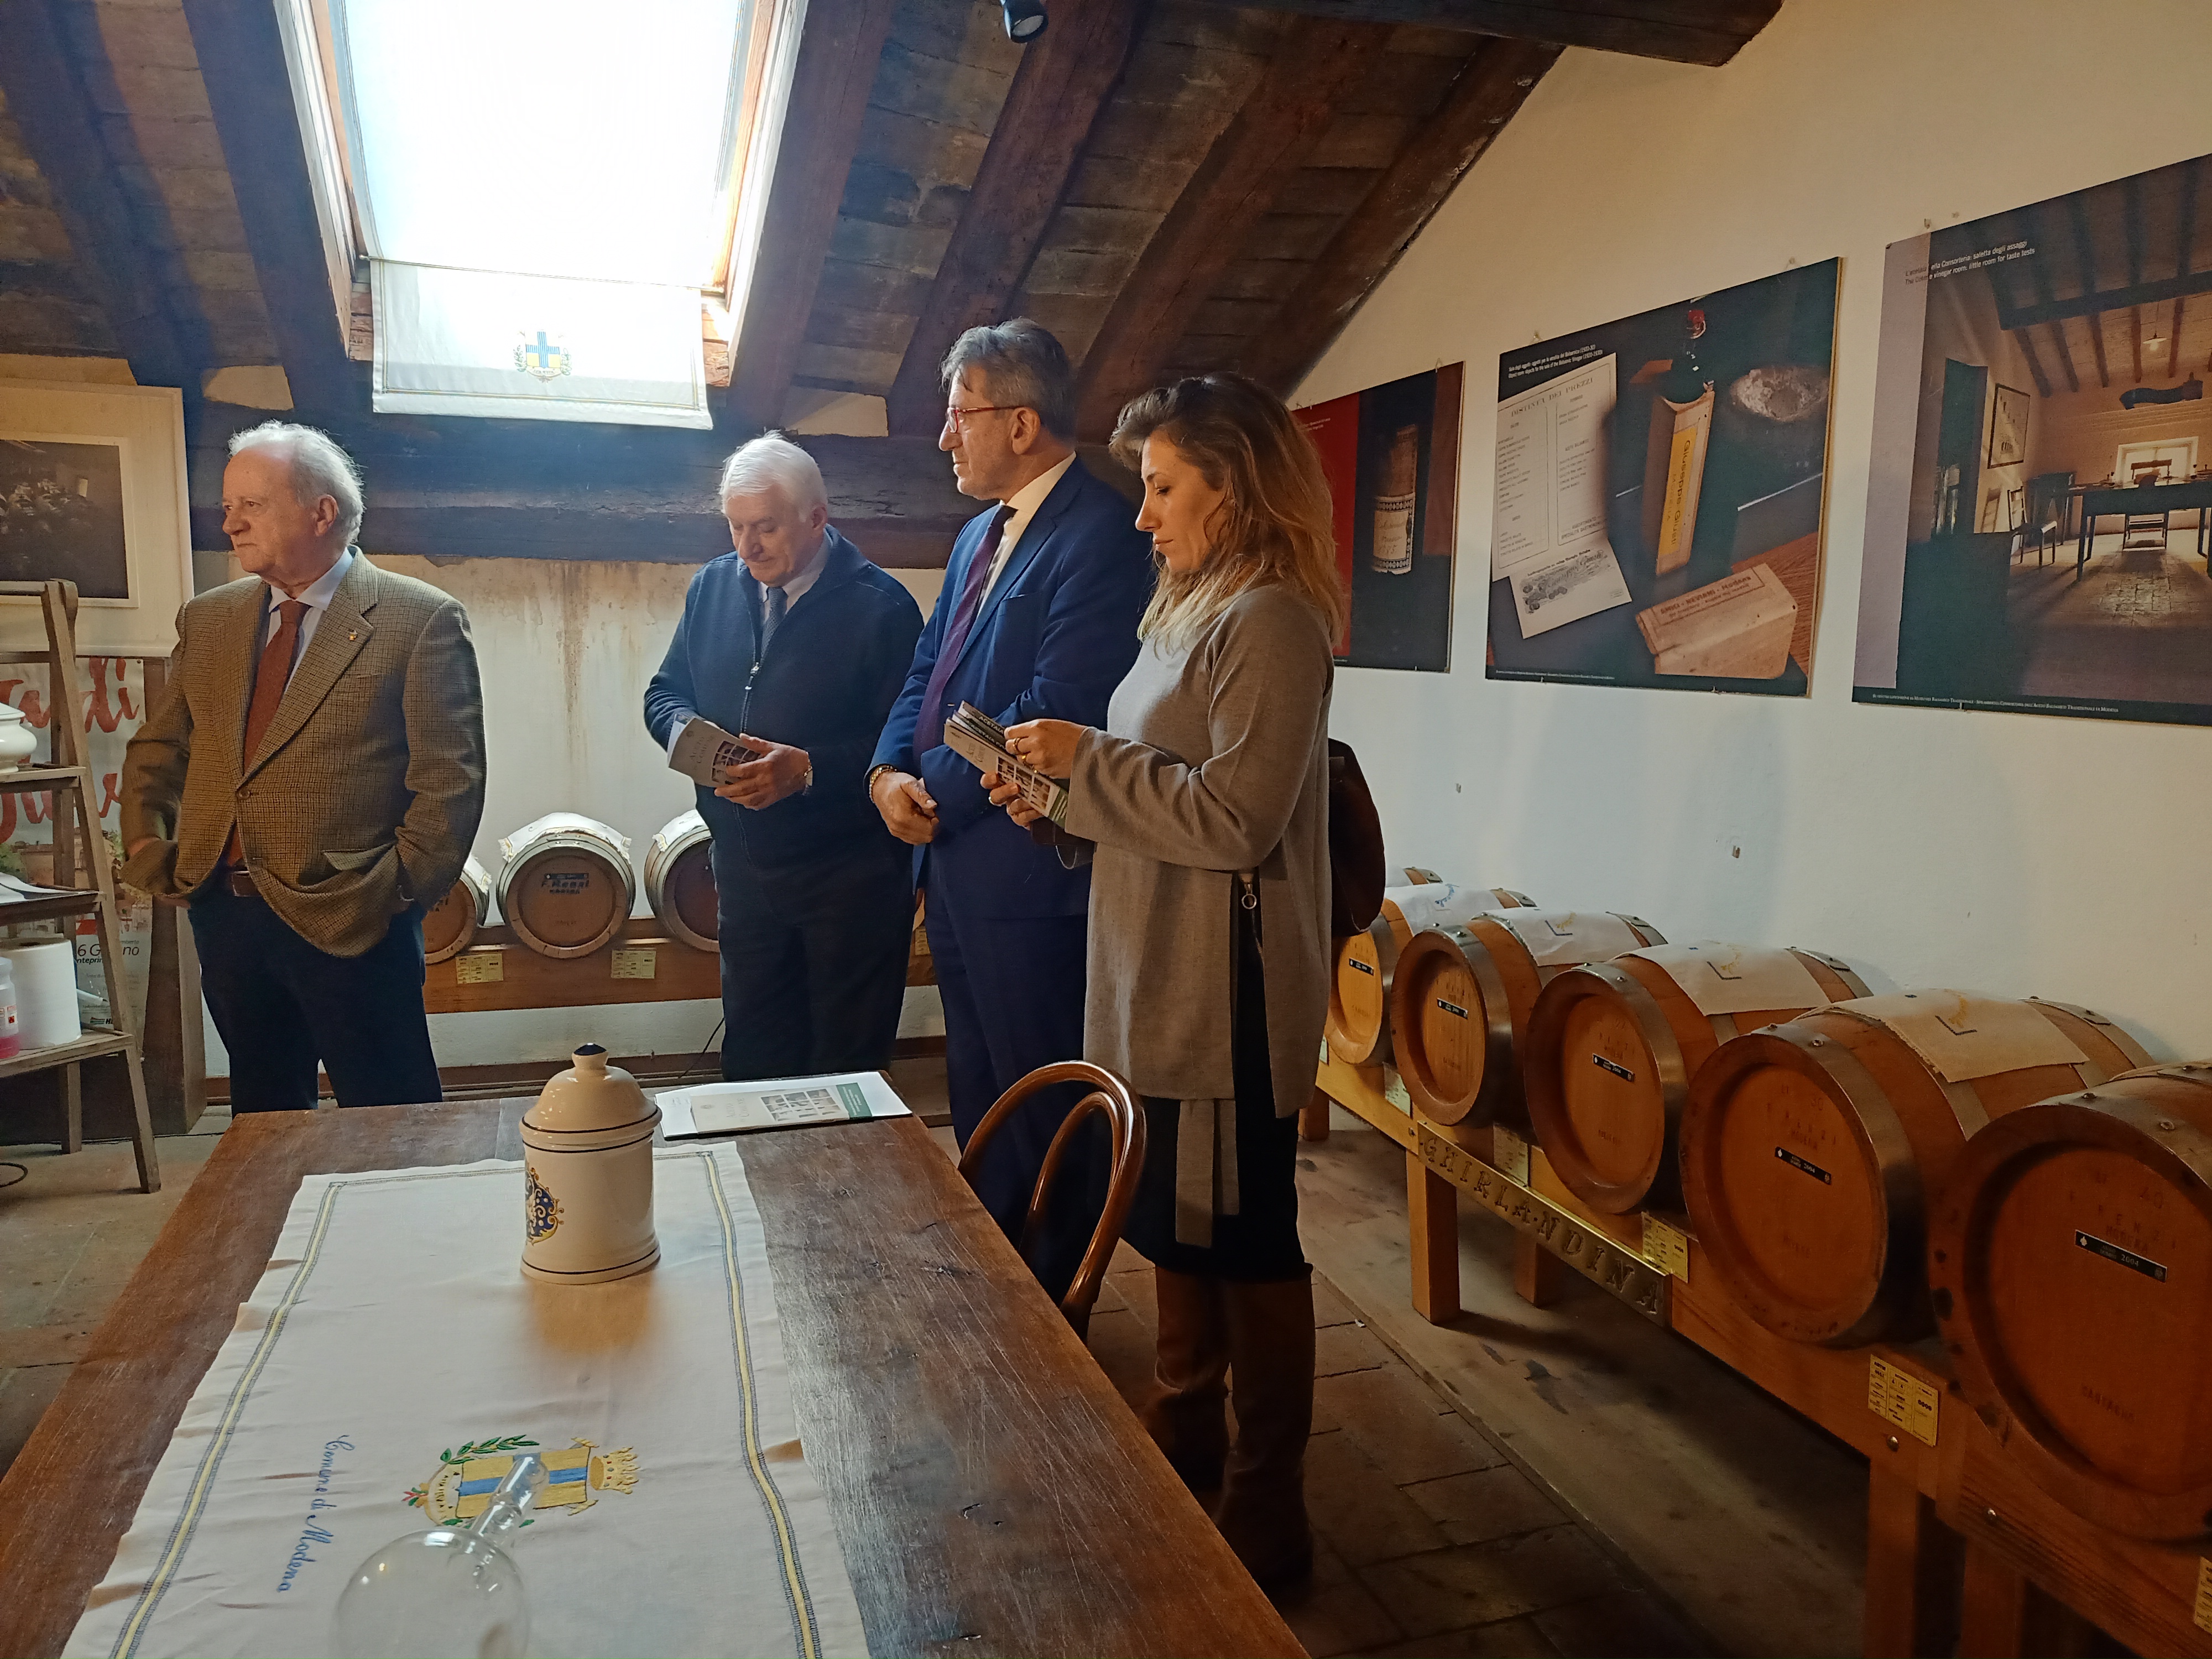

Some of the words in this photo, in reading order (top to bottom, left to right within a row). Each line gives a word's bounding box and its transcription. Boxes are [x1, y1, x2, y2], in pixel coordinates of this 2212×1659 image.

[1942, 254, 1971, 267] Consorteria:
[1973, 251, 1991, 260] saletta
[1992, 245, 2006, 255] degli
[2007, 240, 2027, 251] assaggi
[2006, 252, 2020, 260] taste
[2021, 248, 2035, 257] tests
[1549, 392, 1562, 401] DEI
[1566, 378, 1593, 393] PREZZI
[1677, 440, 1691, 505] Giuseppe
[1671, 510, 1681, 545] Giusti
[971, 725, 994, 743] ACETAIA
[978, 716, 1003, 734] ACETAIA
[1803, 1162, 1815, 1173] 2004
[1423, 1137, 1660, 1315] GHIRLANDINA
[2120, 1253, 2140, 1268] 2004
[315, 1434, 356, 1492] Comune
[310, 1498, 337, 1510] di
[276, 1514, 335, 1593] Modena
